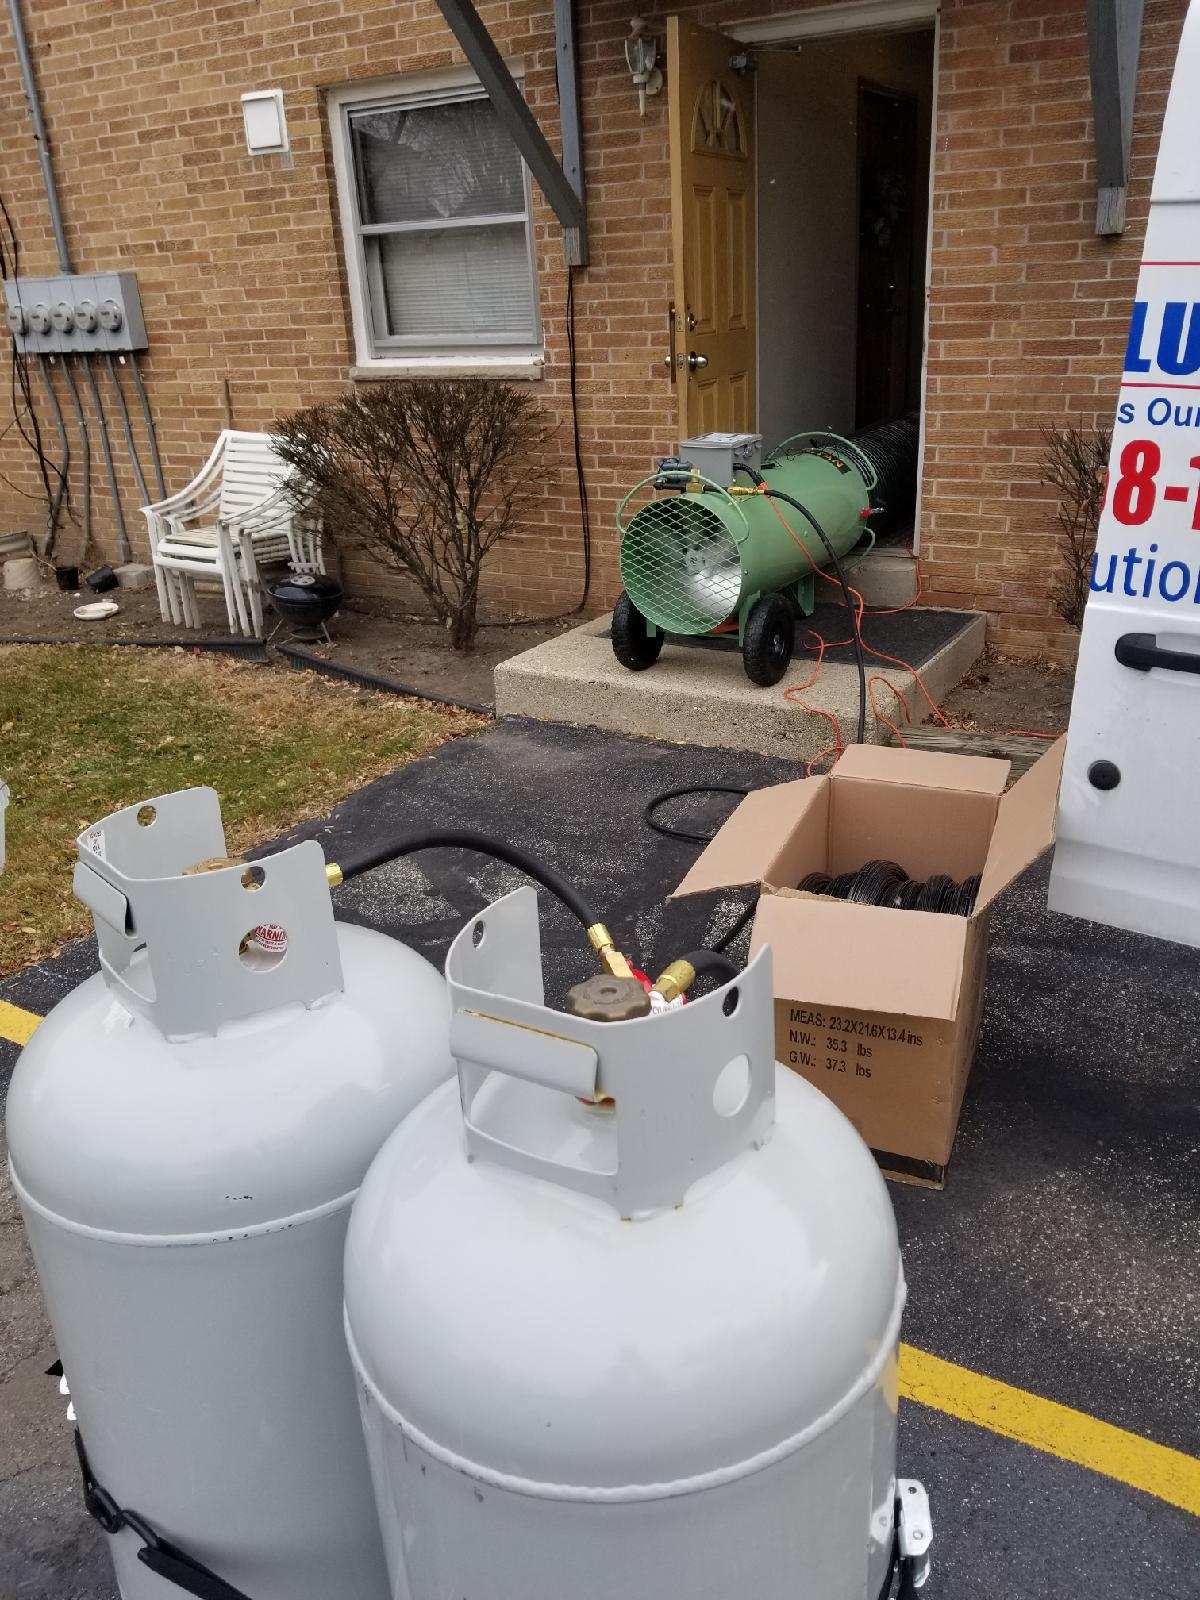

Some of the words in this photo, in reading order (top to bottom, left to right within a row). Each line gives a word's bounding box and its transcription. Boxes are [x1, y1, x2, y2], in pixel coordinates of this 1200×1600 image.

[1089, 543, 1200, 604] utio
[789, 1008, 826, 1028] MEAS:
[826, 1036, 847, 1053] 35.3
[857, 1043, 873, 1058] lbs
[825, 1057, 847, 1073] 37.3
[855, 1063, 872, 1079] lbs
